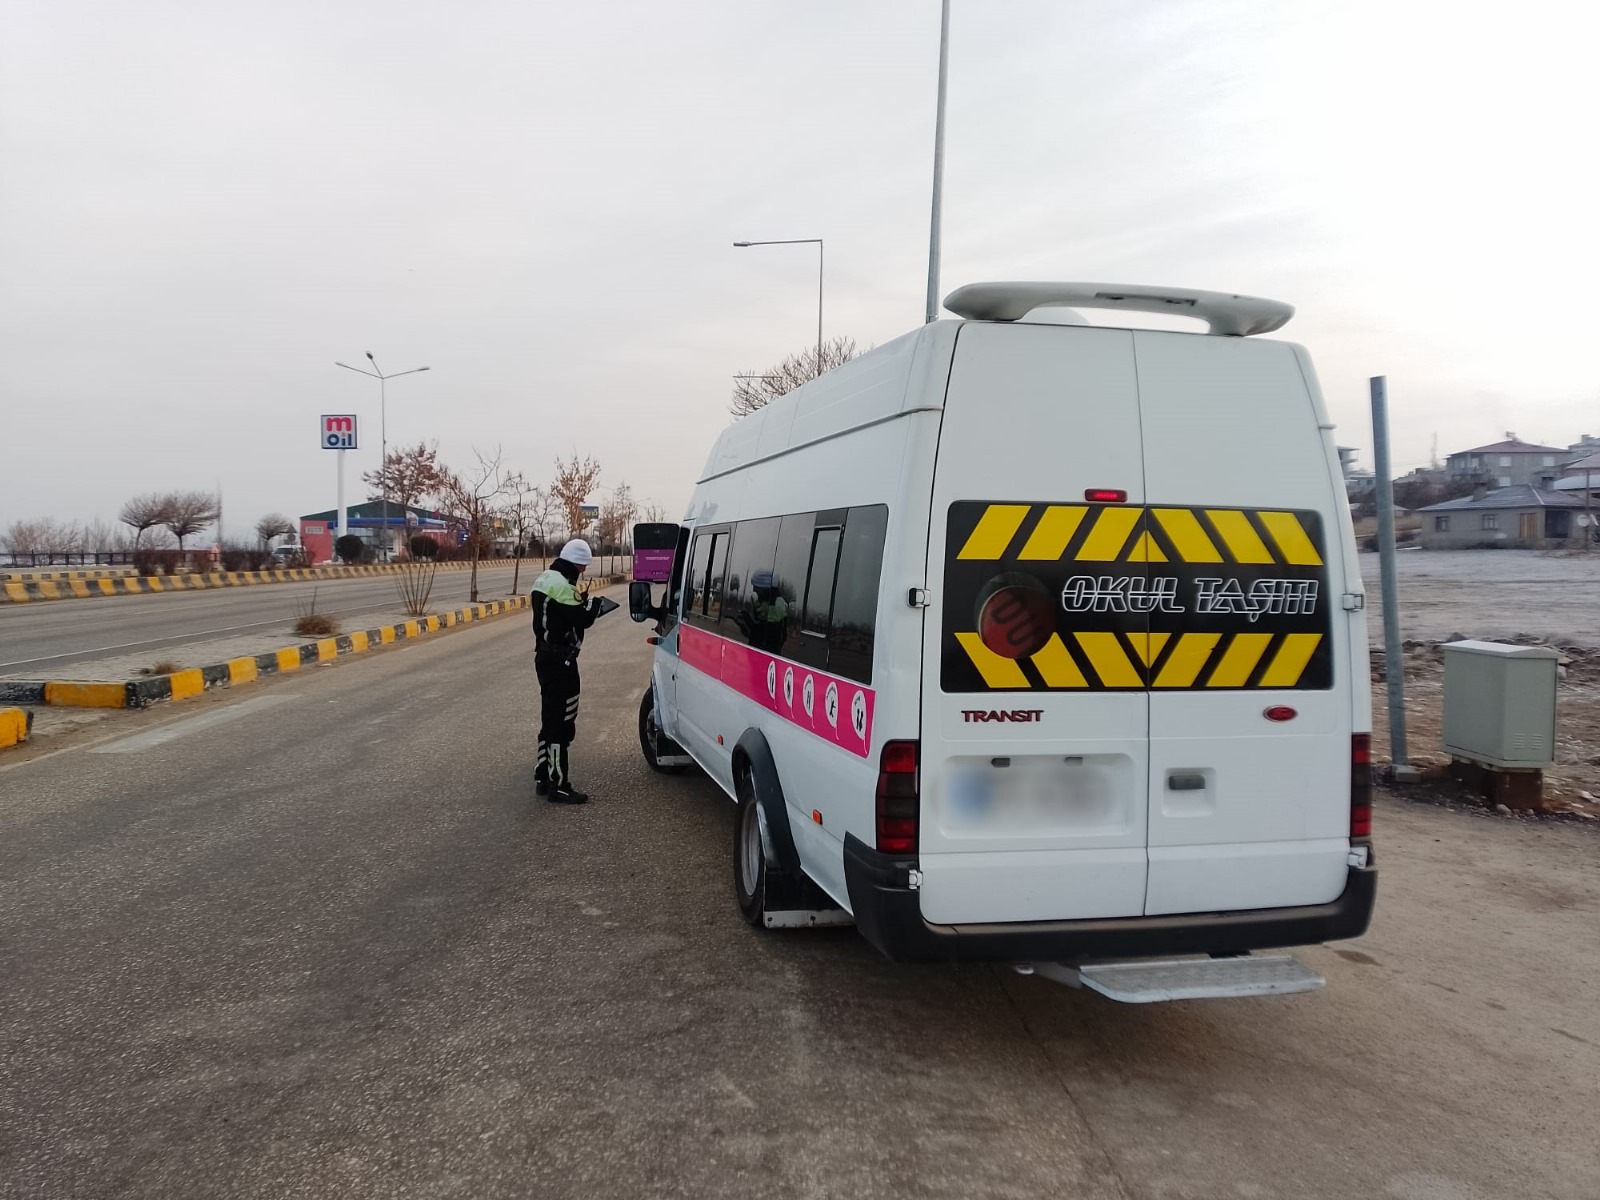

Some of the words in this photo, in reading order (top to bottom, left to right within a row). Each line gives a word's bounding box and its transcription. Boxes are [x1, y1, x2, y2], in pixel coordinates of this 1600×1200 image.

[326, 417, 352, 432] m
[1062, 575, 1185, 612] OKUL
[960, 710, 1044, 722] TRANSIT
